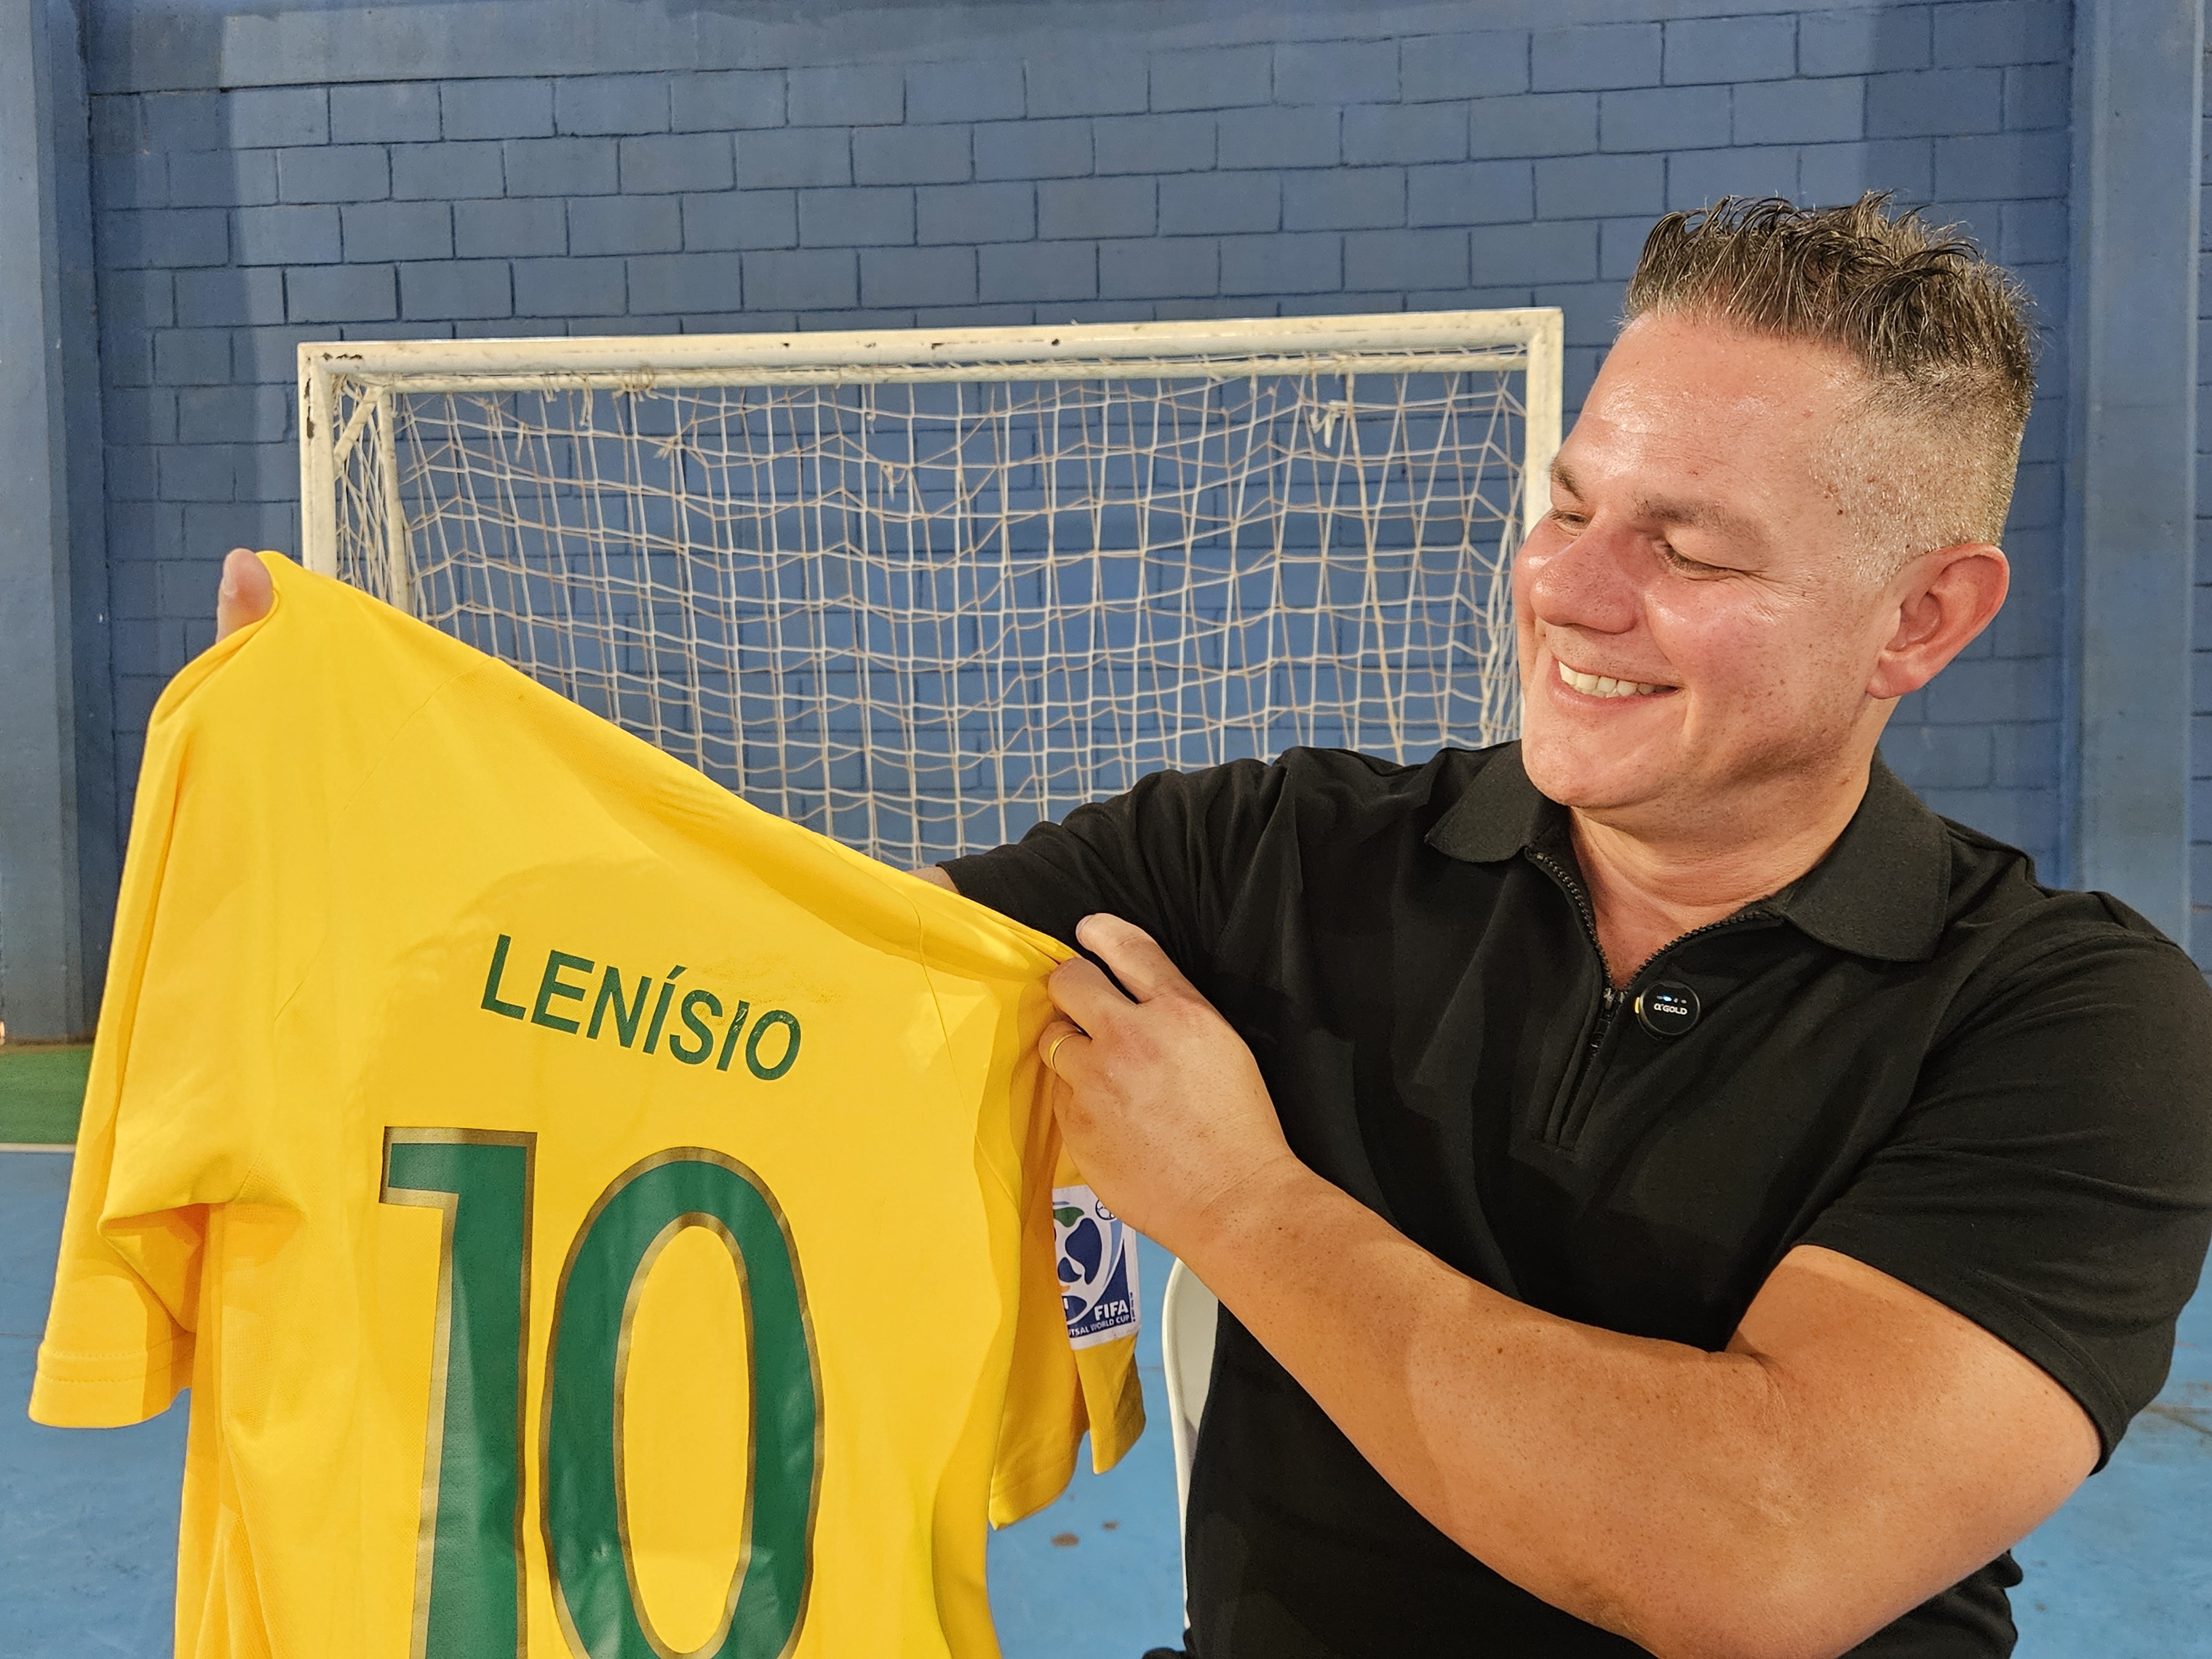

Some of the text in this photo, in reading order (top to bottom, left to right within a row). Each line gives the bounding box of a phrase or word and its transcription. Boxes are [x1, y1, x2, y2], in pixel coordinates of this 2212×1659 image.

[481, 933, 802, 1081] LENÍSIO
[1068, 1314, 1129, 1337] TSAL WORLD CUP
[1094, 1300, 1129, 1321] FIFA
[379, 1126, 825, 1659] 10
